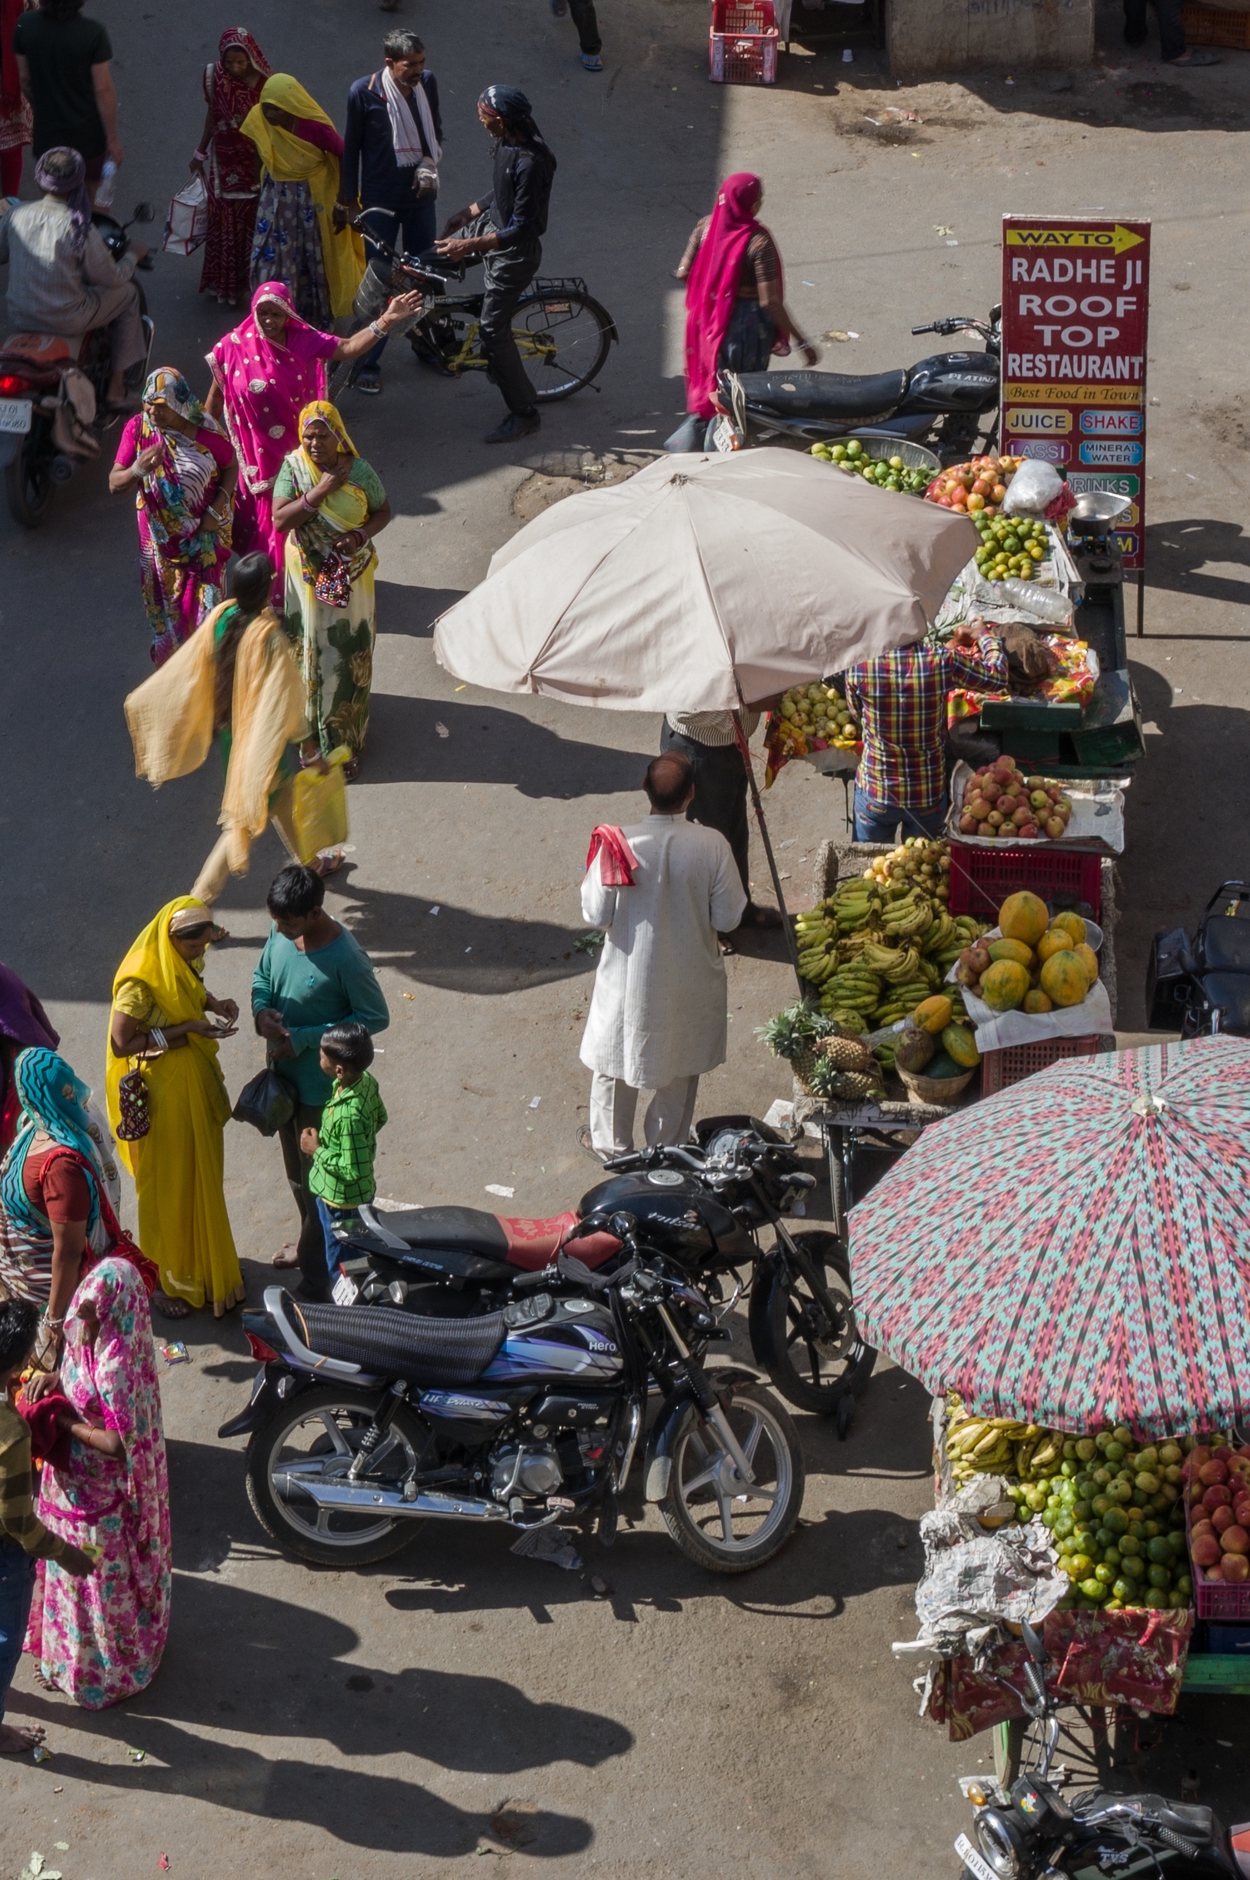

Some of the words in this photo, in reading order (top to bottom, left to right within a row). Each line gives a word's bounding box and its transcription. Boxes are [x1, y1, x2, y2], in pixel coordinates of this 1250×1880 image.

[1016, 231, 1077, 245] WAY
[1077, 232, 1114, 245] TO
[1012, 257, 1116, 285] RADHE
[1122, 259, 1142, 291] JI
[1018, 294, 1138, 318] ROOF
[1033, 324, 1120, 348] TOP
[1007, 352, 1144, 380] RESTAURANT
[948, 372, 998, 384] PLATINA
[1010, 385, 1041, 400] Best
[1044, 386, 1080, 401] Food
[1083, 387, 1098, 400] in
[1100, 387, 1140, 401] Town
[1010, 414, 1066, 429] JUICE
[1083, 414, 1139, 430] SHAKE
[1009, 443, 1065, 460] LASSI
[1085, 443, 1138, 453] MINERAL
[1091, 453, 1131, 463] WATER
[588, 1341, 617, 1352] Hero
[422, 1393, 440, 1404] HF
[1100, 1853, 1129, 1864] TVS
